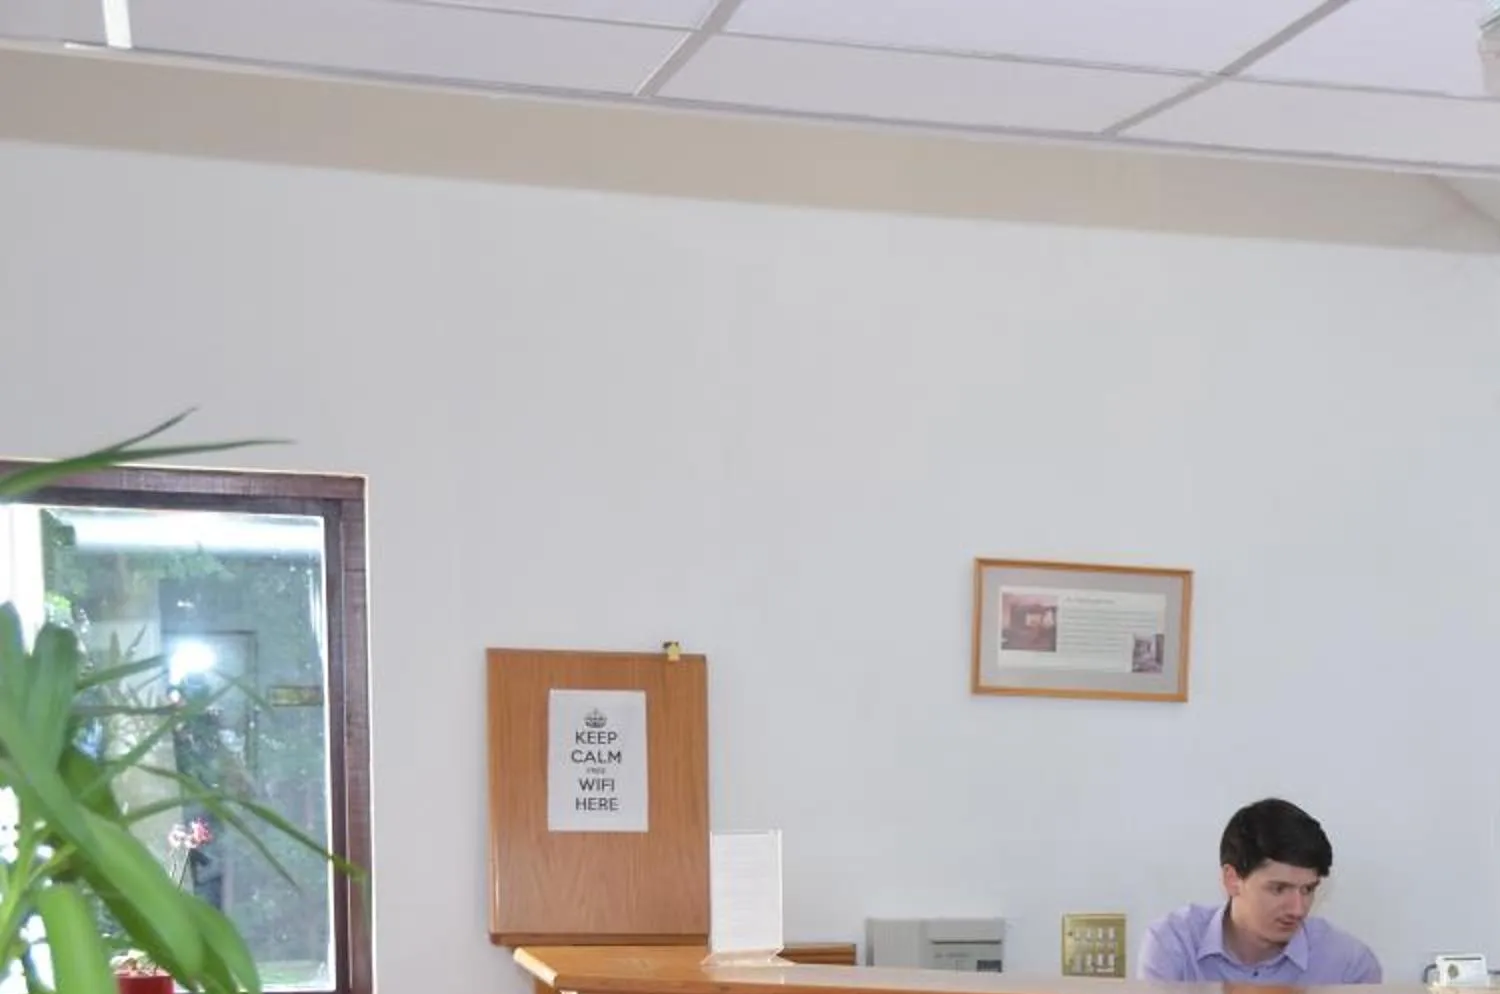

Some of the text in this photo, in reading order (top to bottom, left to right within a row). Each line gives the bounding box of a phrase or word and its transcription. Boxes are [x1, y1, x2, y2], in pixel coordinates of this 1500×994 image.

[575, 731, 618, 745] KEEP
[571, 749, 622, 765] CALM
[579, 778, 615, 792] WIFI
[575, 797, 620, 811] HERE
